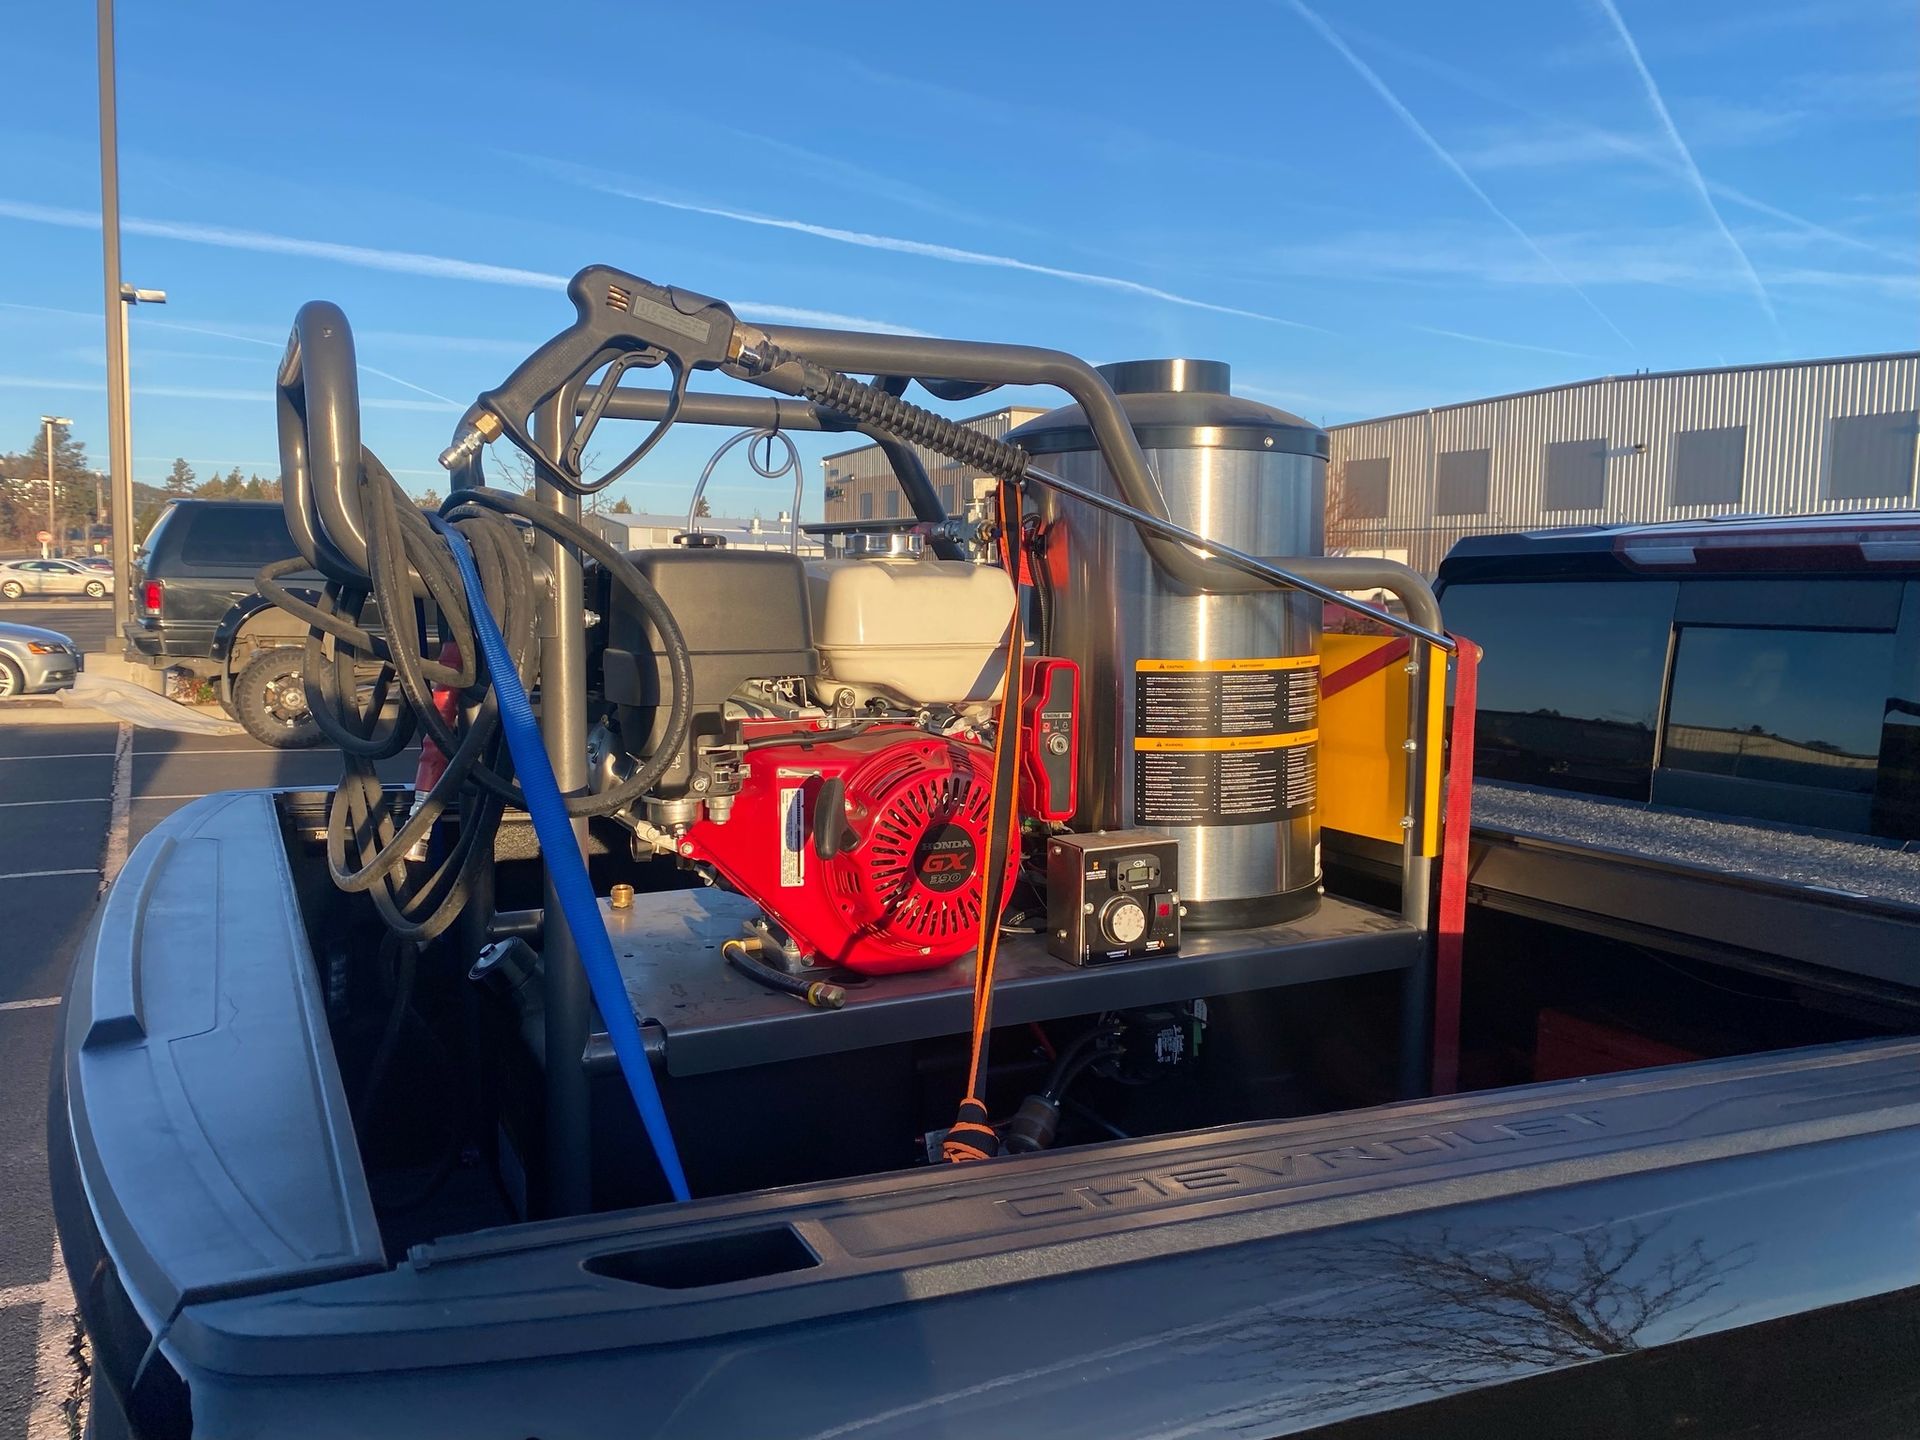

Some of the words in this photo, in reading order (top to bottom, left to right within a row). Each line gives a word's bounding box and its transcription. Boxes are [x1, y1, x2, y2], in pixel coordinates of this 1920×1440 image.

[921, 839, 972, 850] HONDA
[922, 851, 970, 873] GX
[929, 872, 961, 885] 390
[992, 1107, 1608, 1217] CHEVROLET
